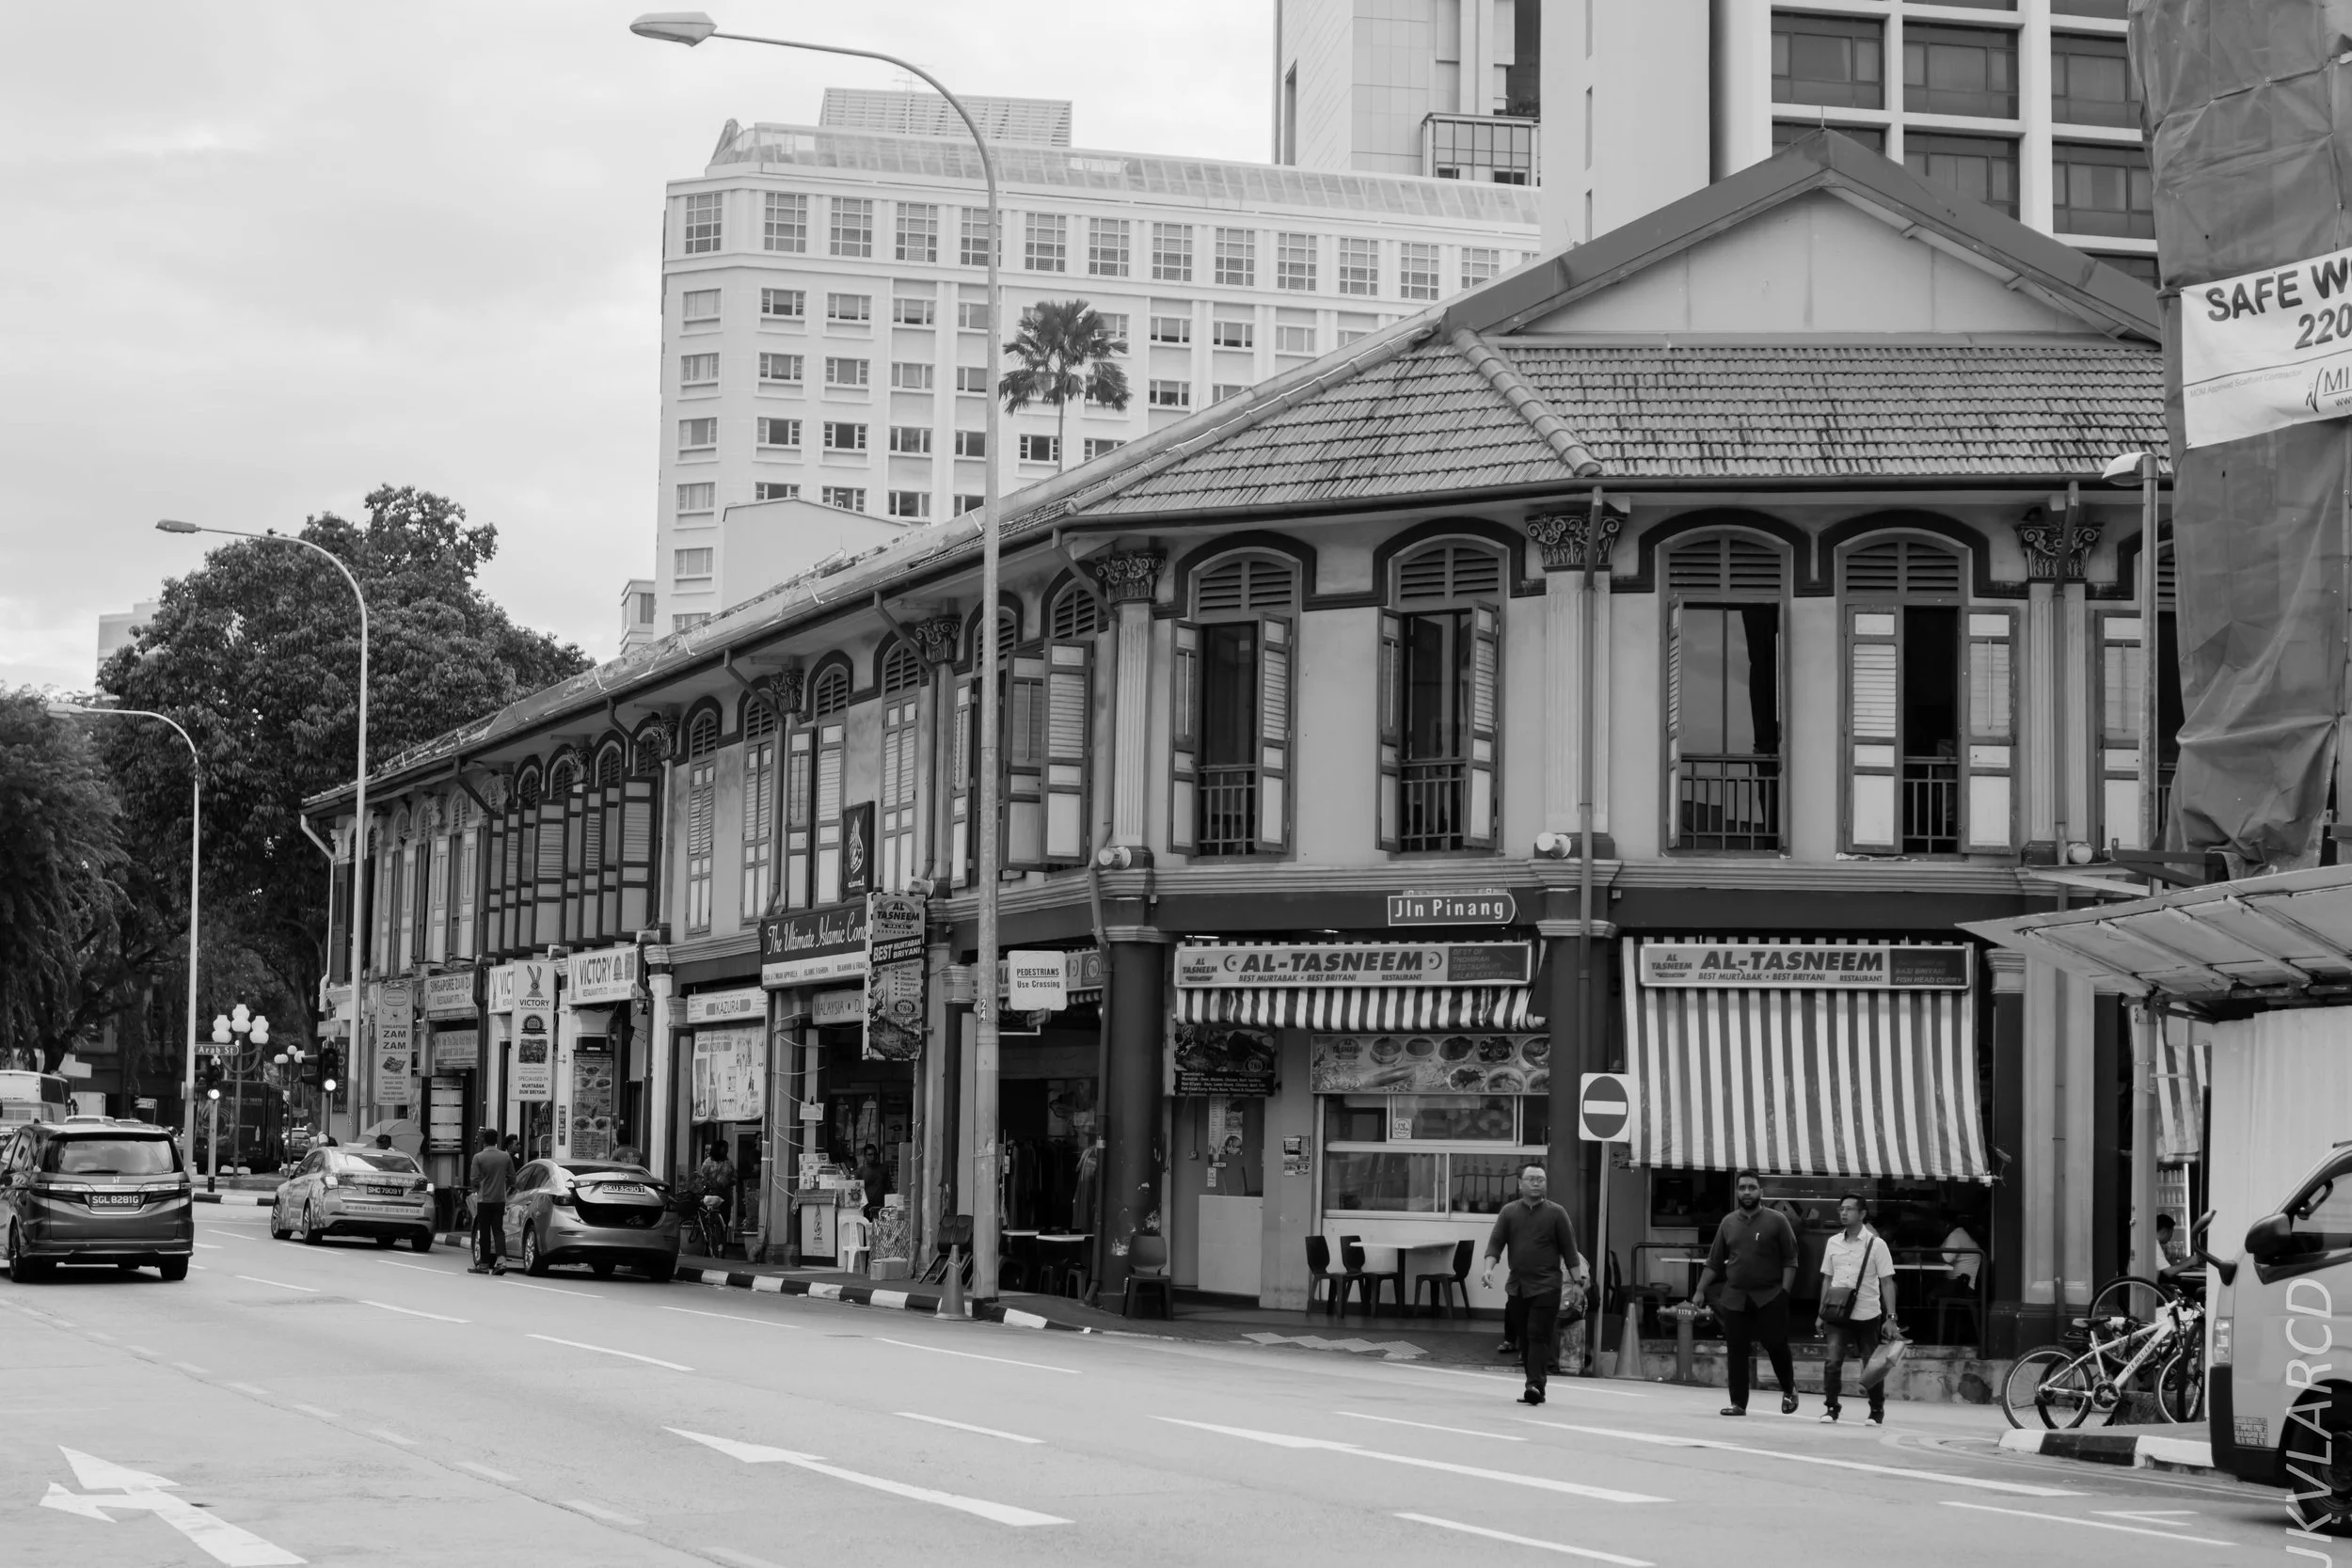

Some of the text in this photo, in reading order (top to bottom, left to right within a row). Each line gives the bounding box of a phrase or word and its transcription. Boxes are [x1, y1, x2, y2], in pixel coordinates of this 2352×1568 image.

[2206, 256, 2352, 322] SAFE W
[2295, 302, 2352, 350] 220
[2189, 369, 2303, 398] MOM Approved Scaffold Contractor
[893, 902, 904, 911] AL
[1394, 898, 1504, 919] Jln Pinang
[877, 911, 919, 921] TASNEEM
[767, 923, 782, 955] The
[784, 920, 815, 952] Ultimate
[816, 914, 846, 947] Islamic
[893, 938, 921, 950] MURTABAK
[873, 943, 893, 961] BEST
[893, 946, 921, 958] BRIYANI
[1195, 958, 1205, 966] AL
[1240, 951, 1423, 973] AL-TASNEEM
[1700, 951, 1883, 972] AL-TASNEEM
[580, 956, 612, 985] VICTORY
[1016, 967, 1059, 976] PEDESTRIANS
[1182, 965, 1217, 974] TASNEEM
[1792, 973, 1826, 981] BRIYANI
[430, 978, 454, 992] SINGAPORE
[1017, 980, 1060, 989] Use Crossing
[1256, 974, 1298, 982] MURTABAK
[716, 999, 739, 1014] KAZURA
[814, 1001, 844, 1017] MALAYSIA
[980, 999, 986, 1021] 24
[224, 1046, 233, 1054] St
[336, 1044, 346, 1101] MONEY
